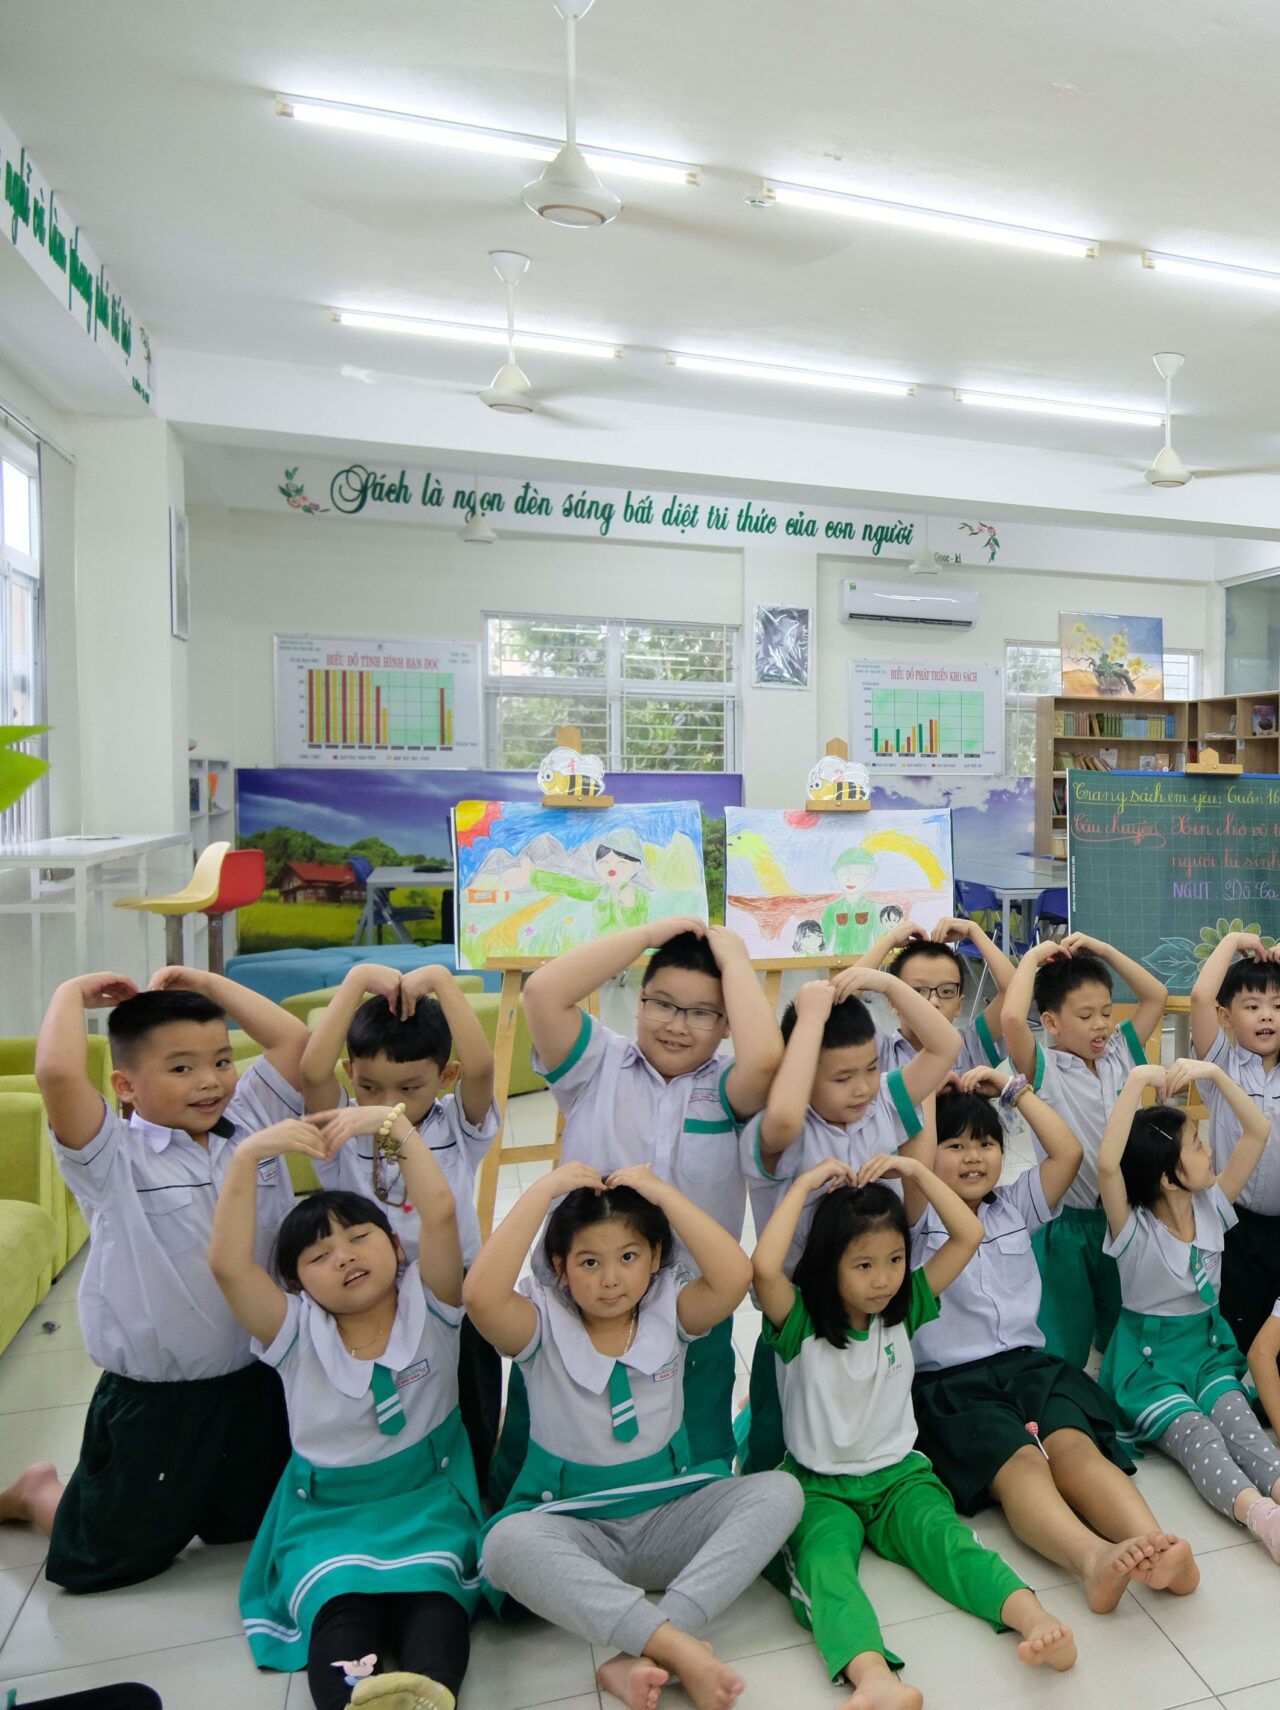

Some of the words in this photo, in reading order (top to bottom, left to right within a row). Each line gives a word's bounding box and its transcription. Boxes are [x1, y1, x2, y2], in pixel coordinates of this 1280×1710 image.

[330, 464, 412, 515] Sách
[422, 472, 444, 506] là
[452, 489, 505, 523] ngọn
[514, 482, 553, 516] đèn
[562, 489, 615, 536] sáng
[623, 490, 654, 525] bất
[662, 495, 698, 535] diệt
[736, 502, 777, 535] thức
[785, 511, 818, 538] của
[825, 518, 855, 540] con
[862, 519, 914, 556] người
[567, 758, 577, 774] 1
[832, 770, 844, 784] 2
[1073, 783, 1127, 813] Trang
[1130, 782, 1165, 804] sách
[1168, 790, 1190, 803] em
[1268, 787, 1280, 805] 16
